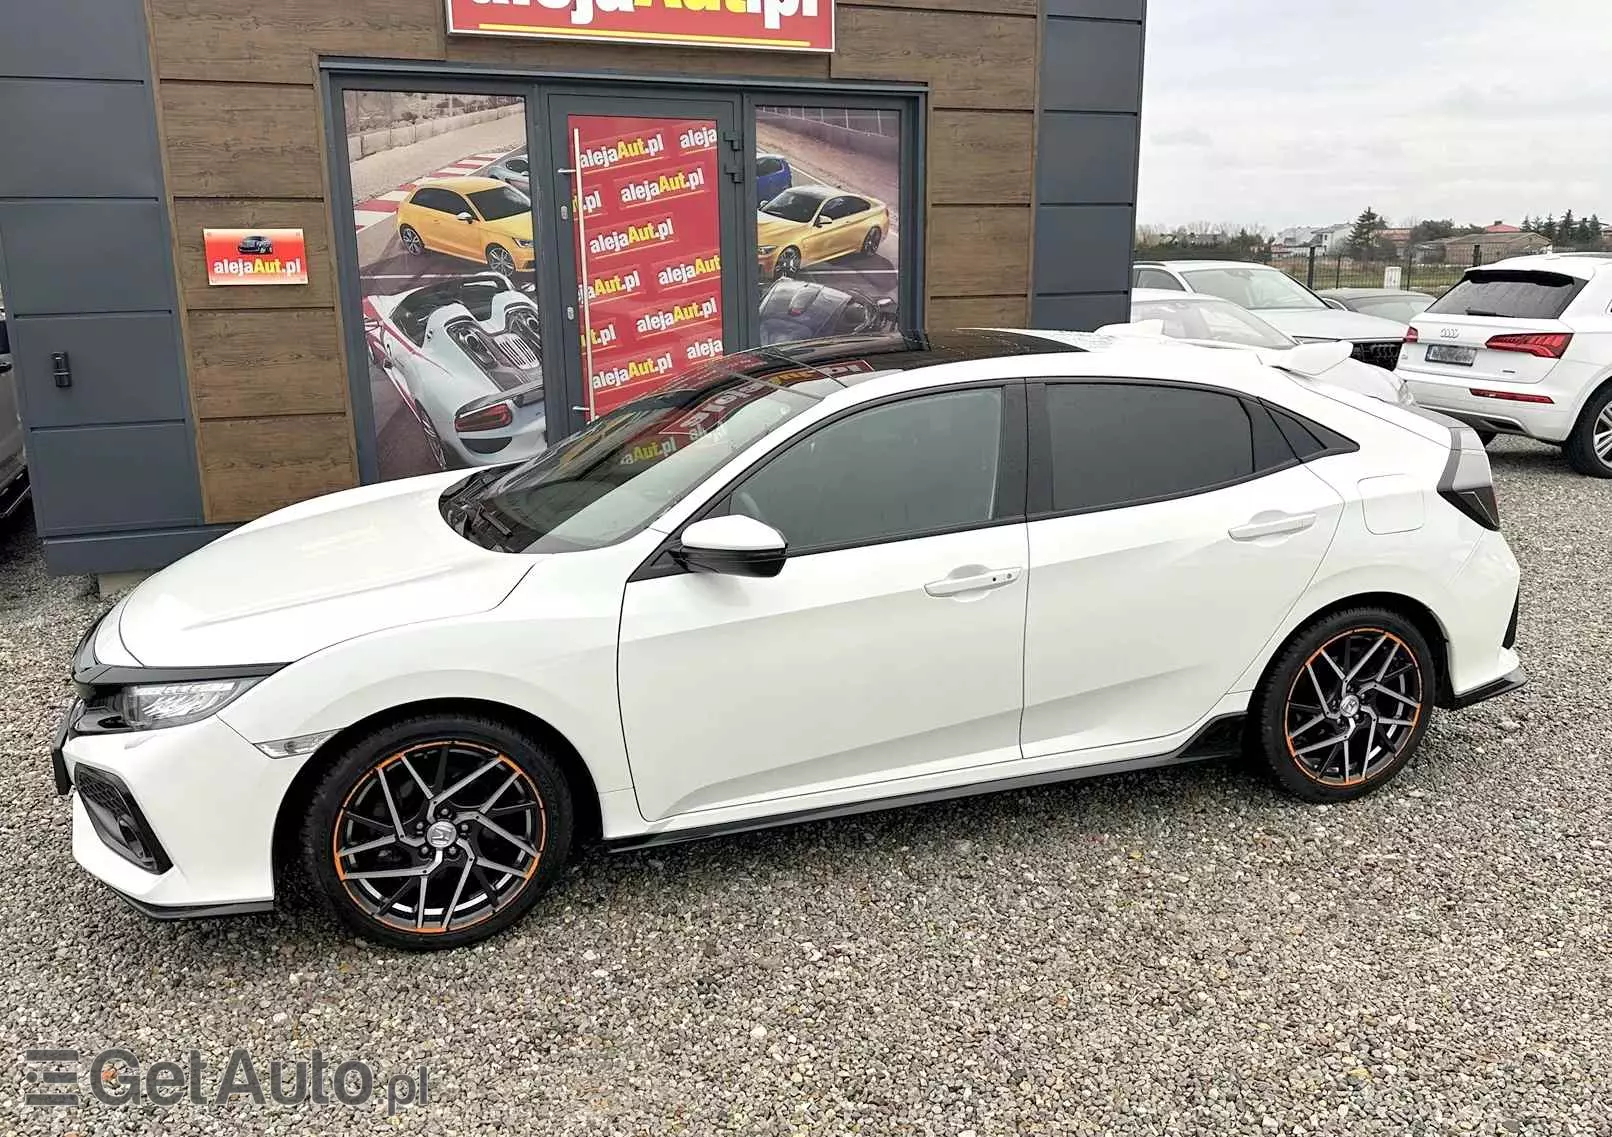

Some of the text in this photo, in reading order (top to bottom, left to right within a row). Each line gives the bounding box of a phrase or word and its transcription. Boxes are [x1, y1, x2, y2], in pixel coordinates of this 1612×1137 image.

[580, 134, 664, 168] alejaAut.pl
[620, 167, 704, 203] alejaAut.pl
[589, 218, 674, 254] alejaAut.pl
[213, 258, 301, 276] alejaAut.pl
[636, 297, 718, 333] alejaAut.pl
[592, 352, 673, 389] alejaAut.pl
